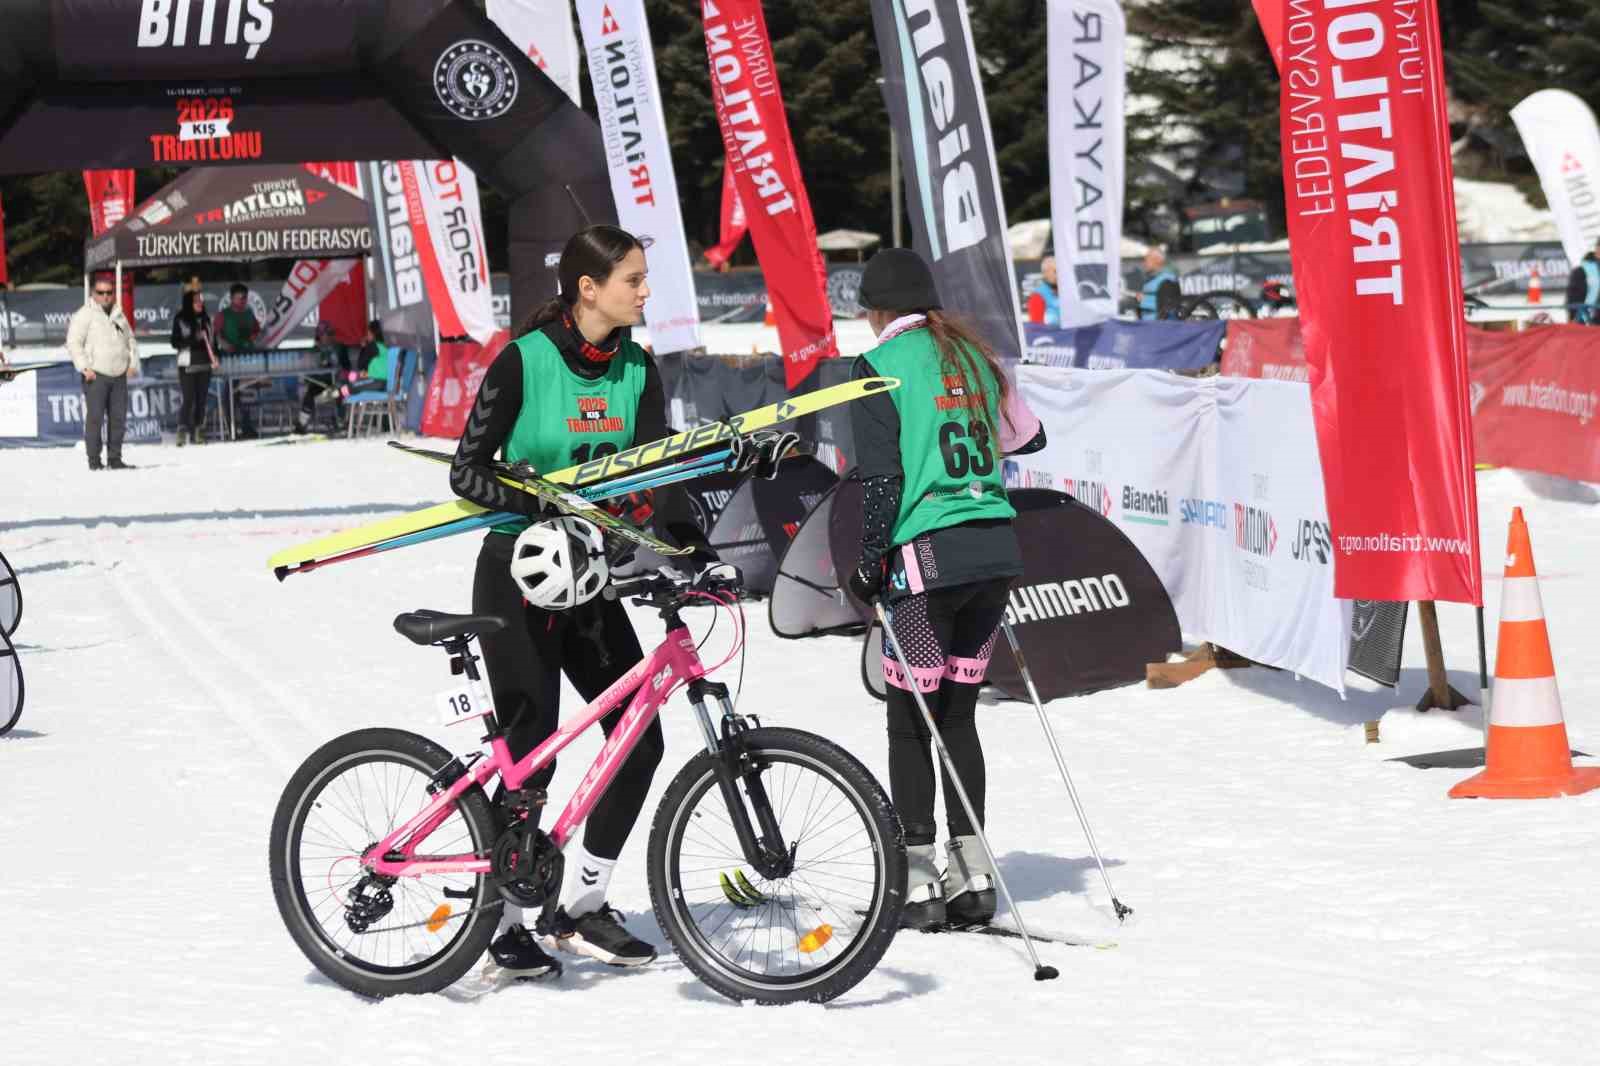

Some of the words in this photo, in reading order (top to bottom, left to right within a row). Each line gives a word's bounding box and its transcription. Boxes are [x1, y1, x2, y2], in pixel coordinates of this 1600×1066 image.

[176, 96, 235, 125] 2026
[192, 123, 216, 137] KIŞ
[137, 229, 201, 257] TÜRKİYE
[282, 226, 373, 250] FEDERASYO
[574, 417, 745, 485] FISCHER
[938, 421, 994, 479] 63
[1122, 485, 1169, 516] Bianchi
[448, 692, 472, 716] 18
